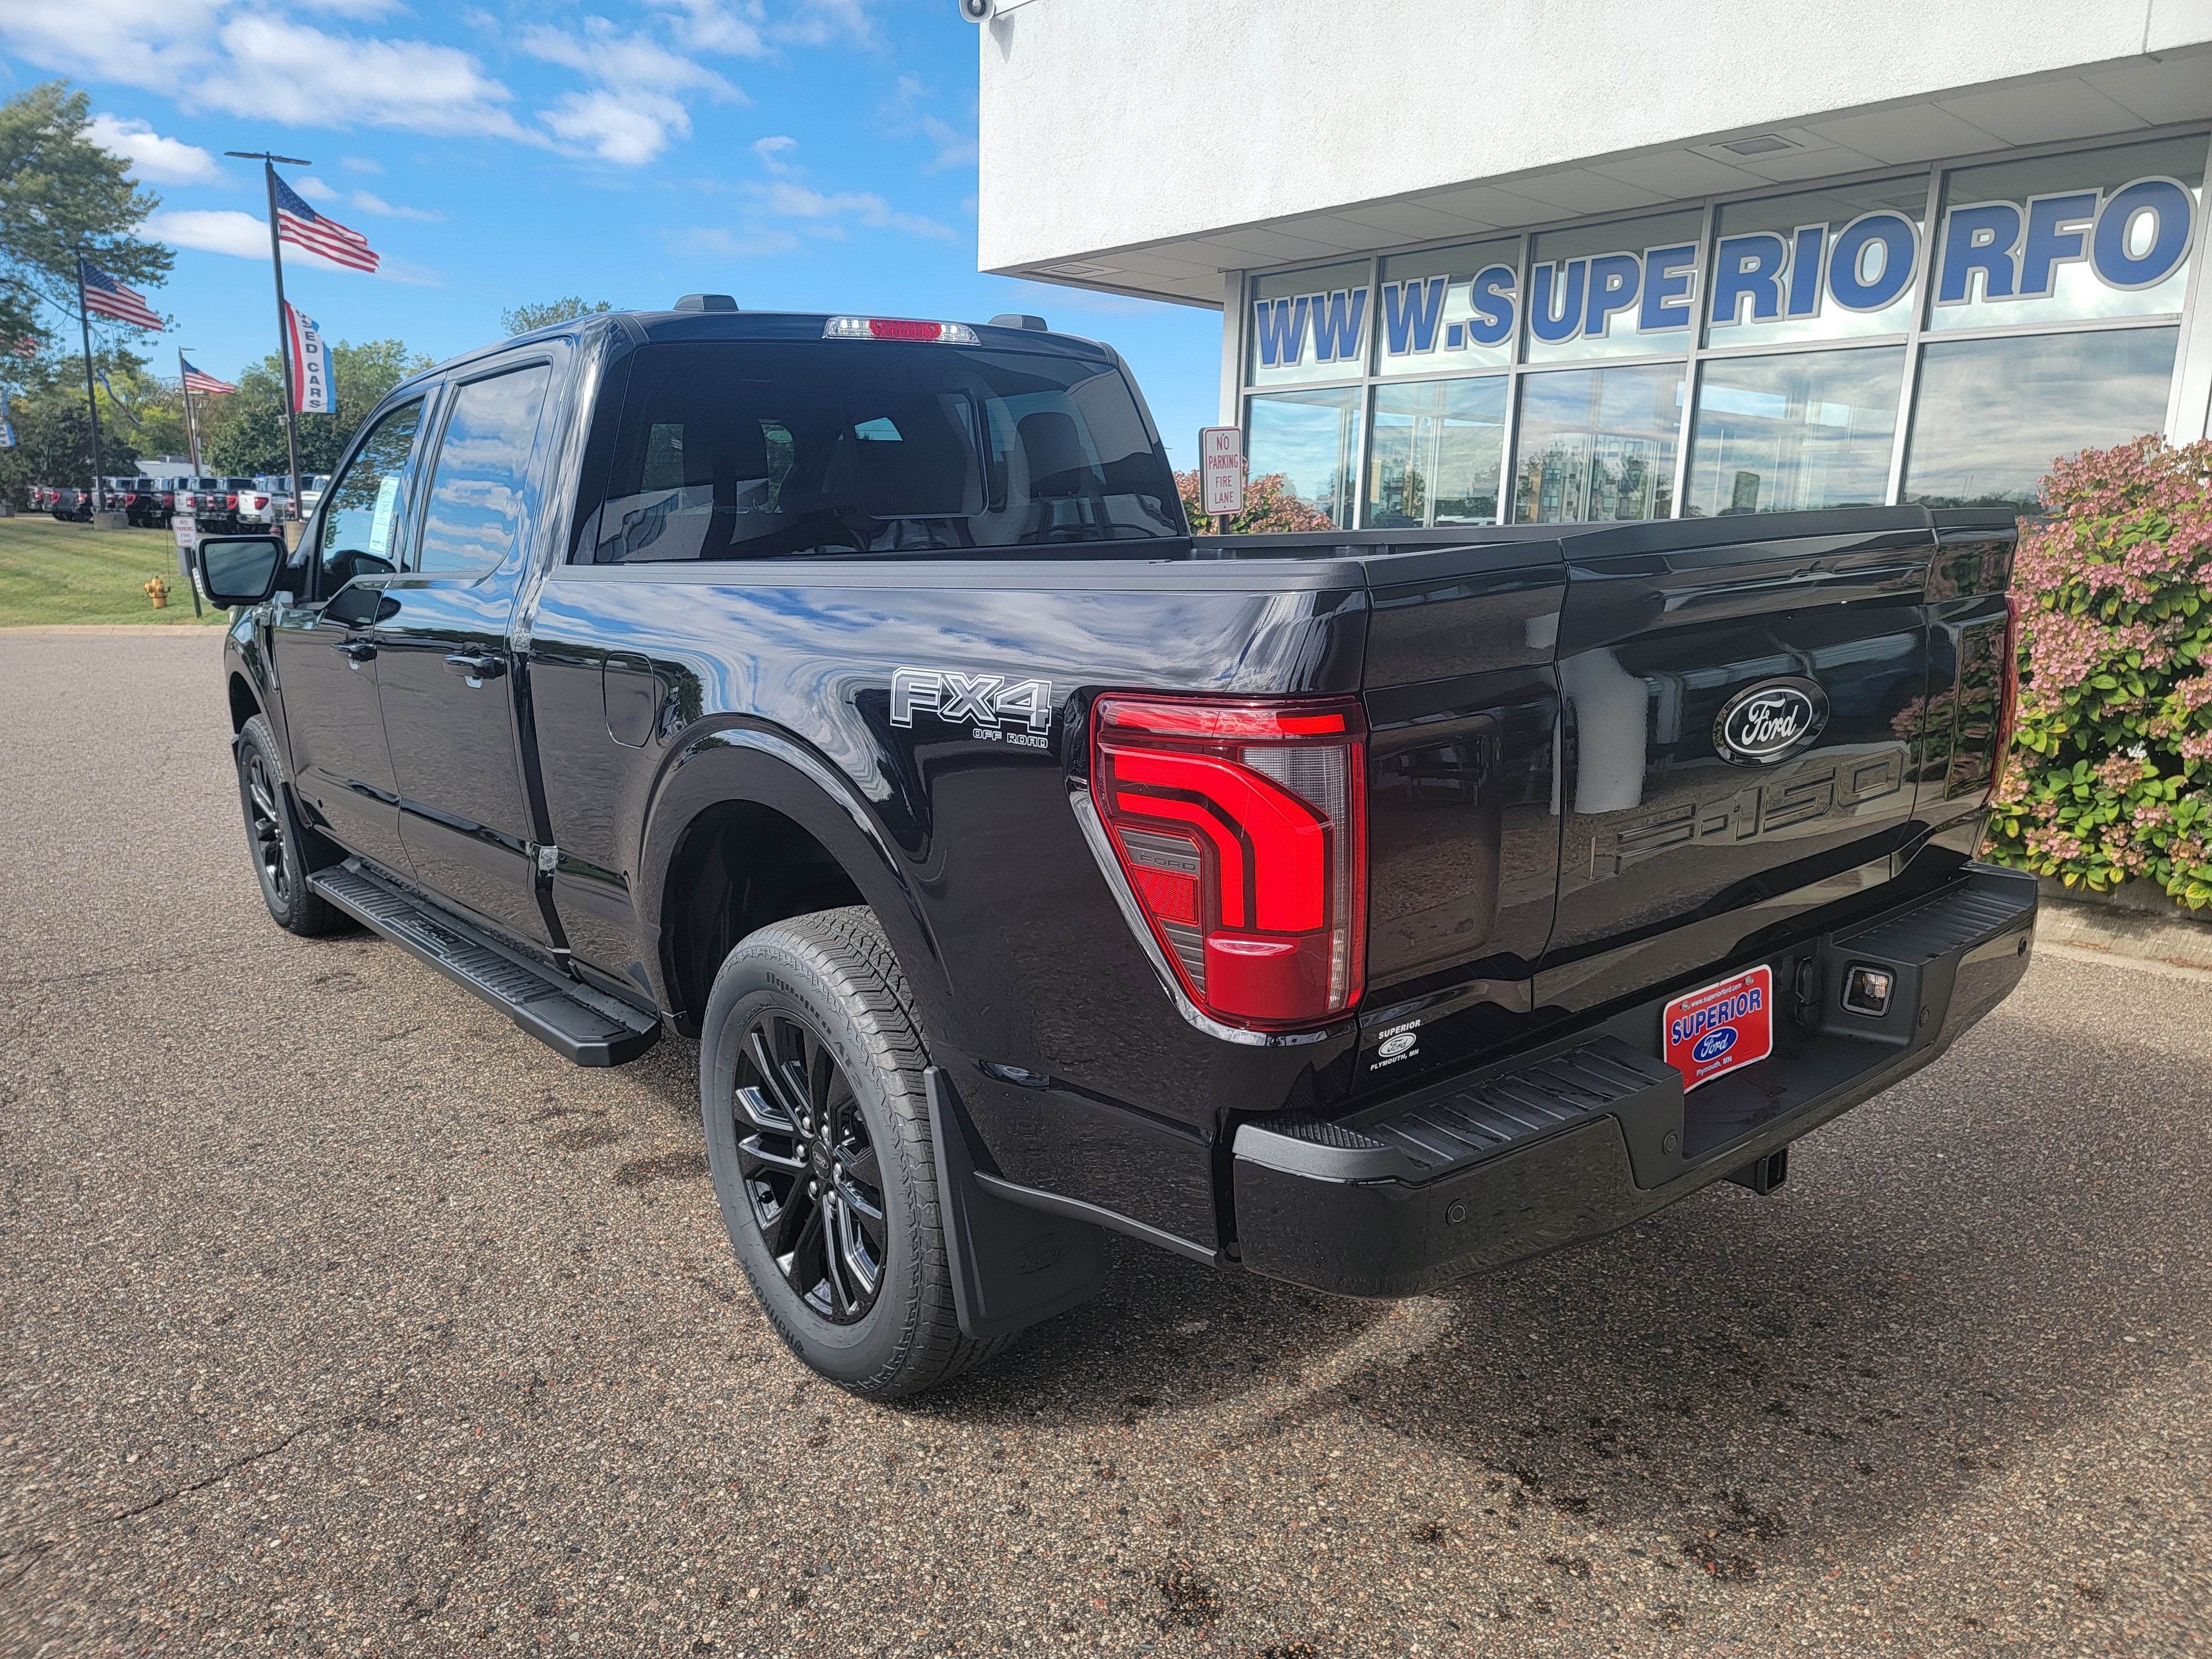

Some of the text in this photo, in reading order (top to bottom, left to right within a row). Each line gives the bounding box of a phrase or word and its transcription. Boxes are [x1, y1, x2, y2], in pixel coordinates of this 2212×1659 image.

[295, 309, 322, 409] USED CARS
[1217, 436, 1229, 451] NO
[1208, 454, 1238, 470] PARKING
[1215, 476, 1232, 488] FIRE
[1214, 492, 1234, 504] LANE
[890, 666, 1052, 735] FX4
[1741, 698, 1799, 745] Ford
[973, 728, 1048, 748] OFF ROAD
[1589, 747, 1904, 882] F-150
[1140, 854, 1196, 872] FORD
[766, 971, 832, 1036] Dynapro
[1671, 987, 1762, 1046] SUPERIOR
[1378, 1019, 1421, 1039] SUPERIOR
[1387, 1038, 1408, 1052] Ford
[1700, 1031, 1729, 1058] Ford
[1370, 1048, 1420, 1071] PLYMOUTH, MN
[1696, 1061, 1722, 1077] Plymouth,
[1723, 1055, 1732, 1065] MN
